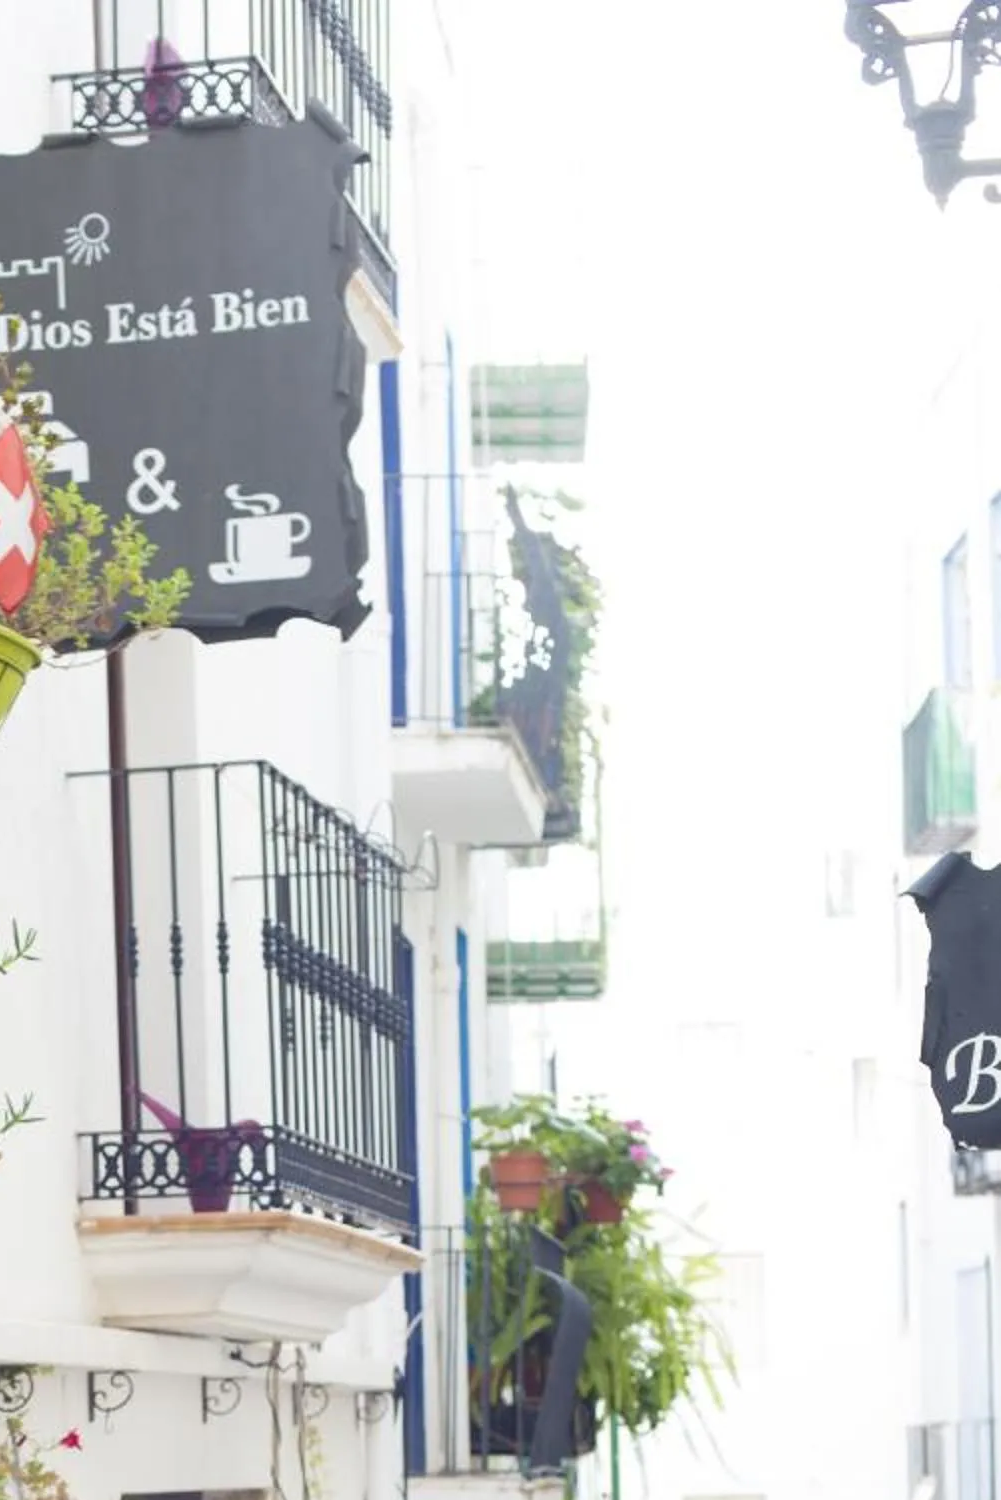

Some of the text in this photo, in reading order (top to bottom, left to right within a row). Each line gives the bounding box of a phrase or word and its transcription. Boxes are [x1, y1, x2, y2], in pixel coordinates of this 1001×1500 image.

[104, 296, 198, 344] Está
[210, 287, 311, 333] Bien
[126, 447, 181, 514] &
